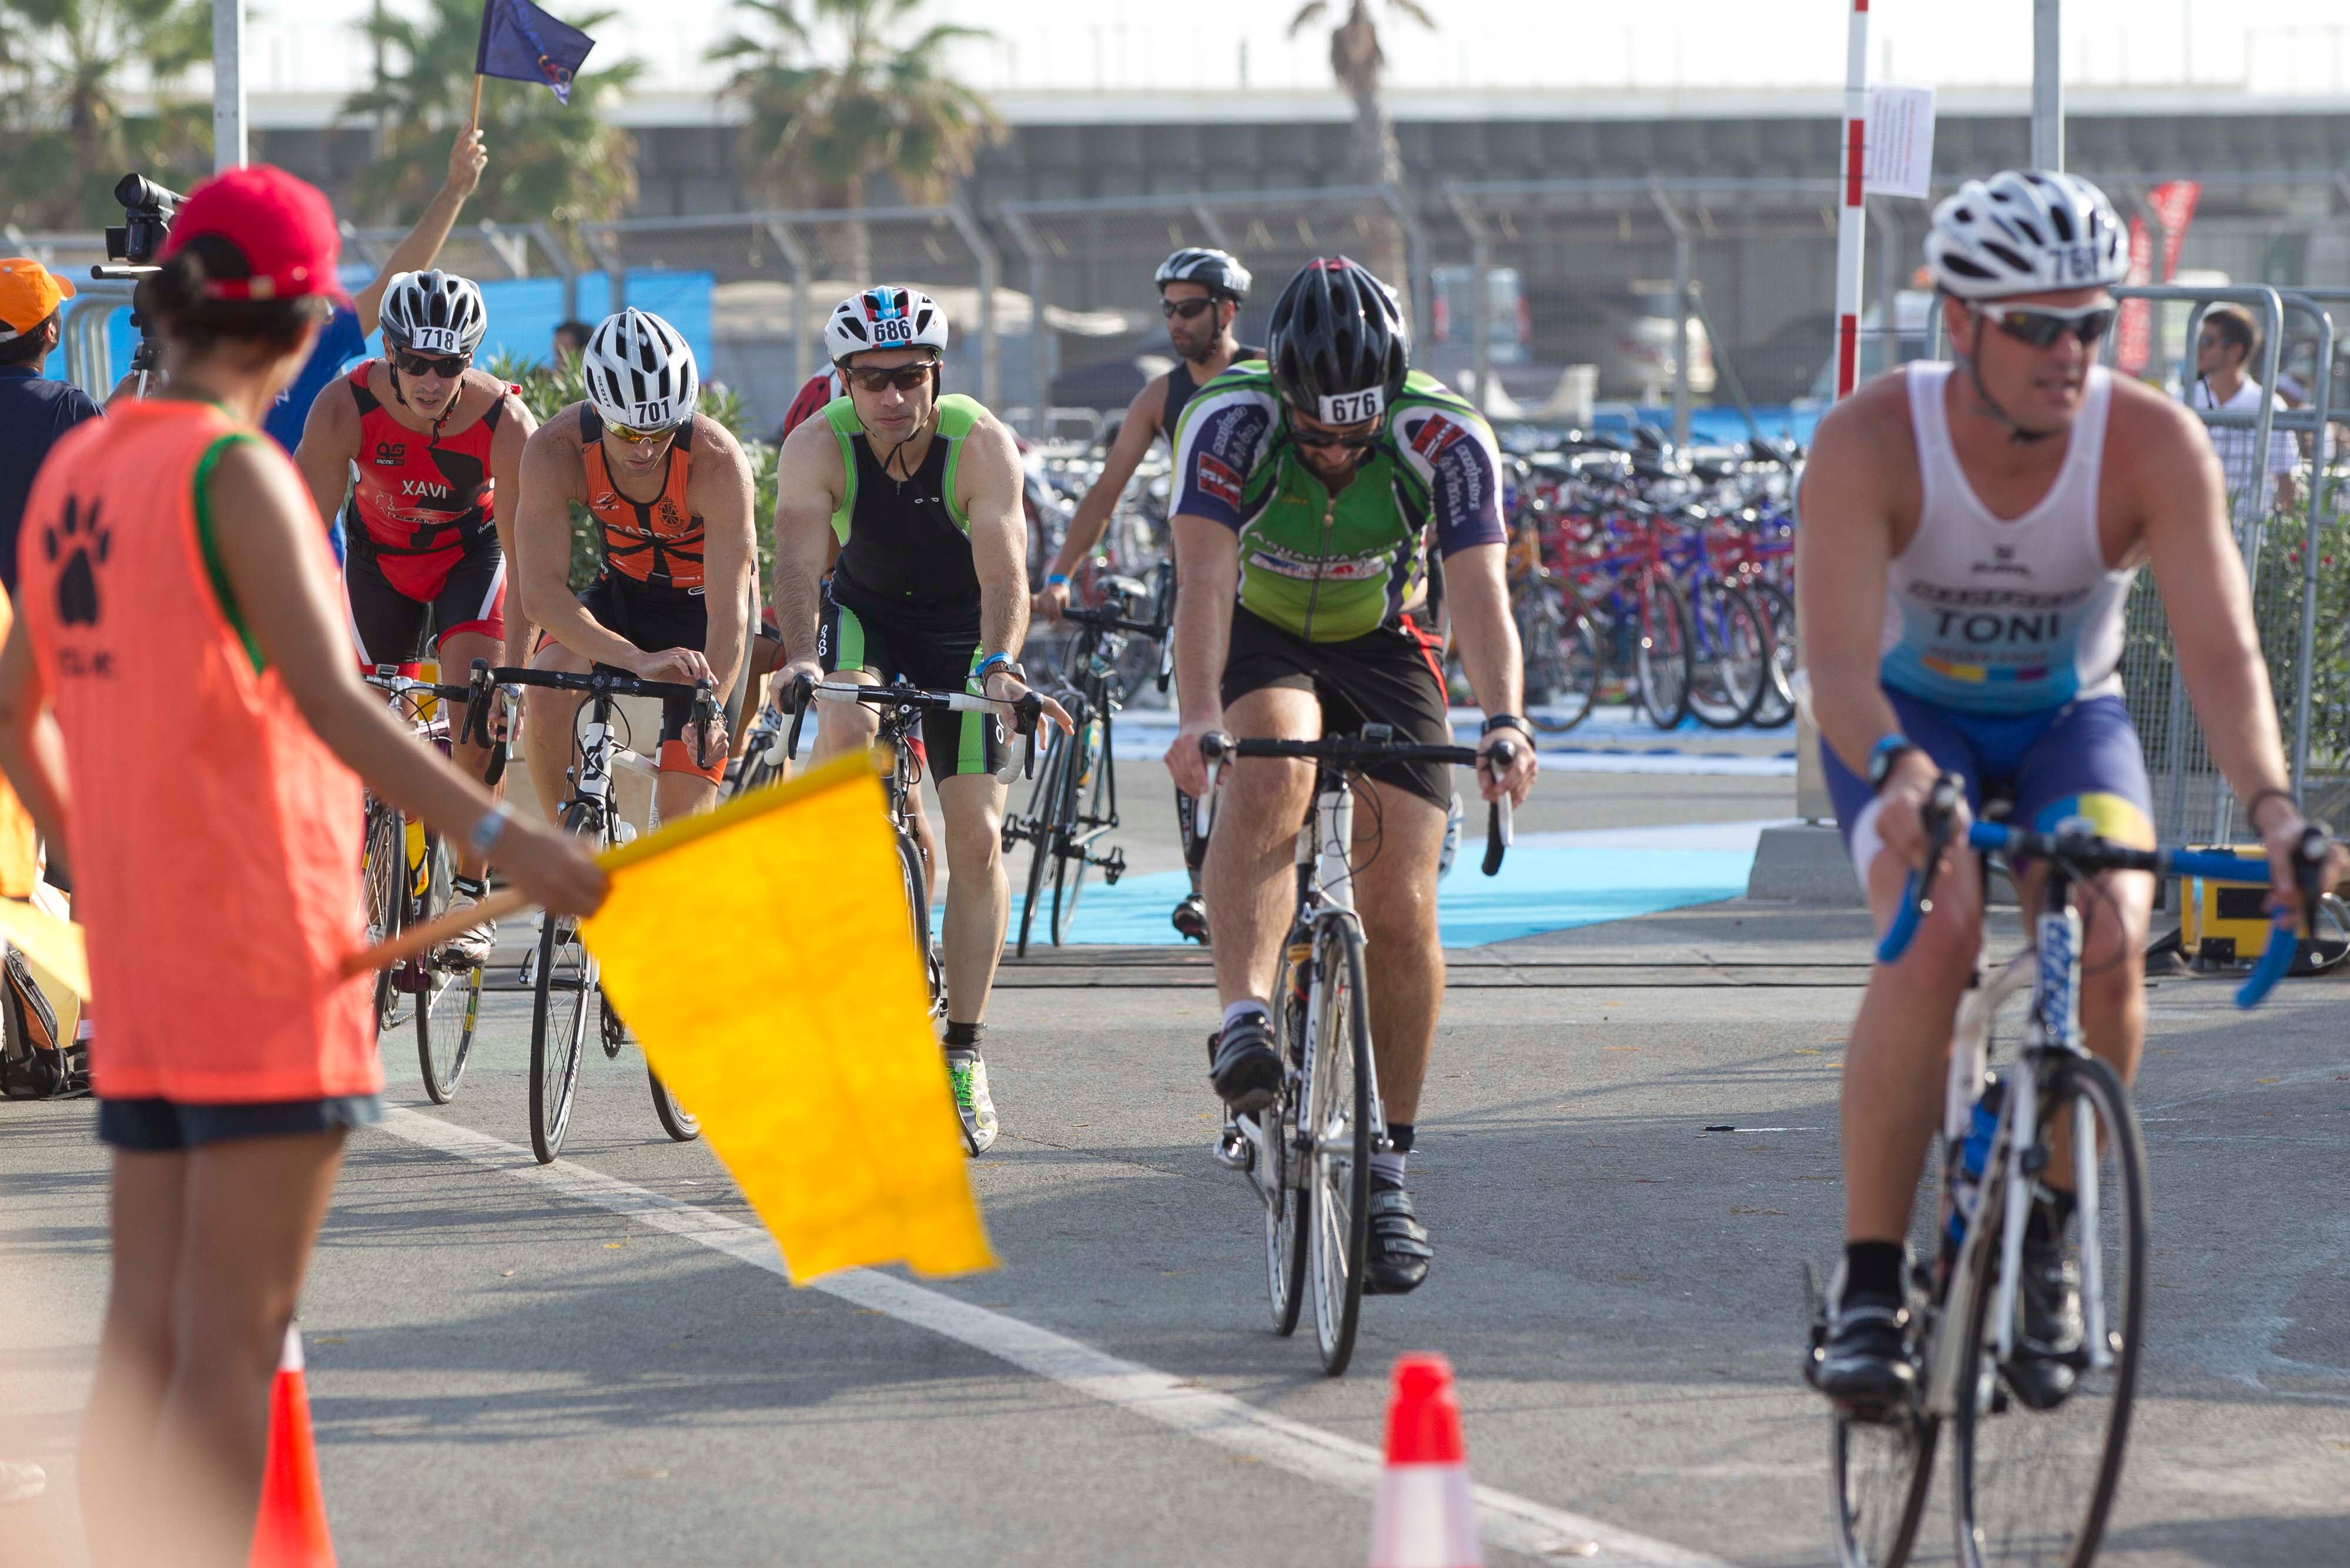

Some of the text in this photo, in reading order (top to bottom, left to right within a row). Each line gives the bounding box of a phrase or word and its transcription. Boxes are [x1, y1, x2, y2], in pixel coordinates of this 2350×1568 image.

[421, 329, 454, 351] 718
[874, 320, 911, 342] 686
[597, 375, 612, 409] SCOTT
[635, 399, 670, 424] 701
[1332, 393, 1376, 421] 676
[401, 480, 446, 499] XAVI
[1934, 609, 2059, 644] TONI
[818, 624, 828, 656] orca
